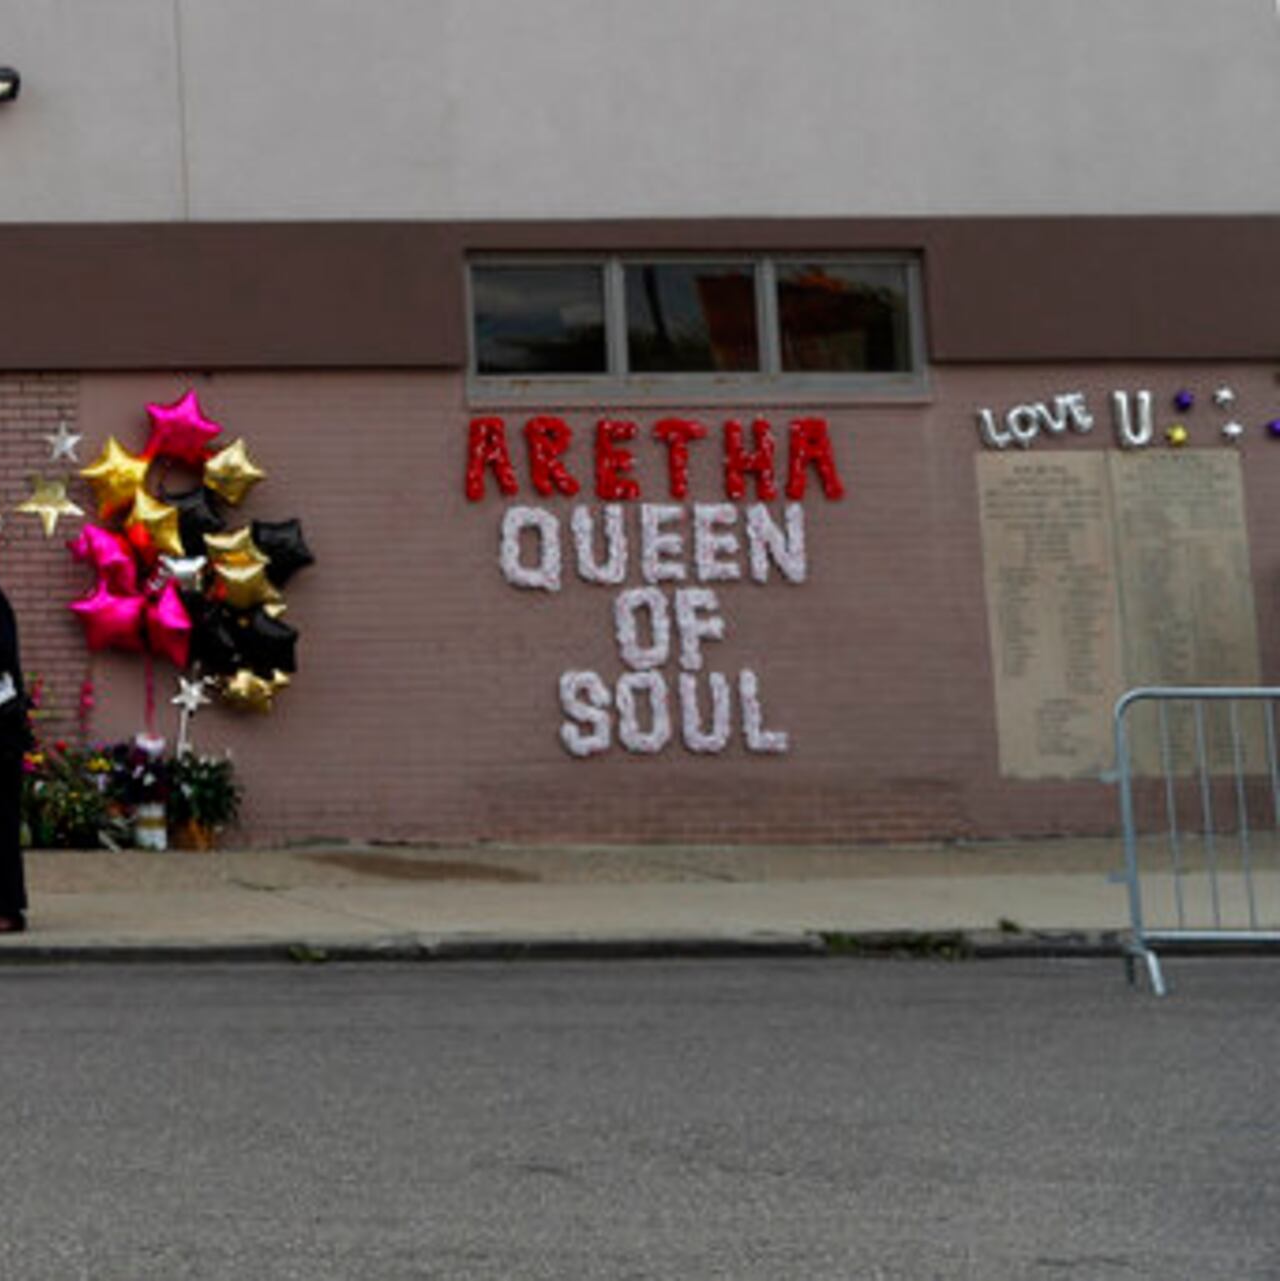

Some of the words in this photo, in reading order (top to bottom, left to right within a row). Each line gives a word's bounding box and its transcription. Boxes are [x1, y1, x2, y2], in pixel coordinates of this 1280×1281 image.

[464, 415, 846, 502] ARETHA
[978, 391, 1095, 451] LOVE
[1112, 389, 1154, 451] U
[499, 502, 807, 591] QUEEN
[615, 587, 725, 672] OF
[558, 668, 789, 757] SOUL
